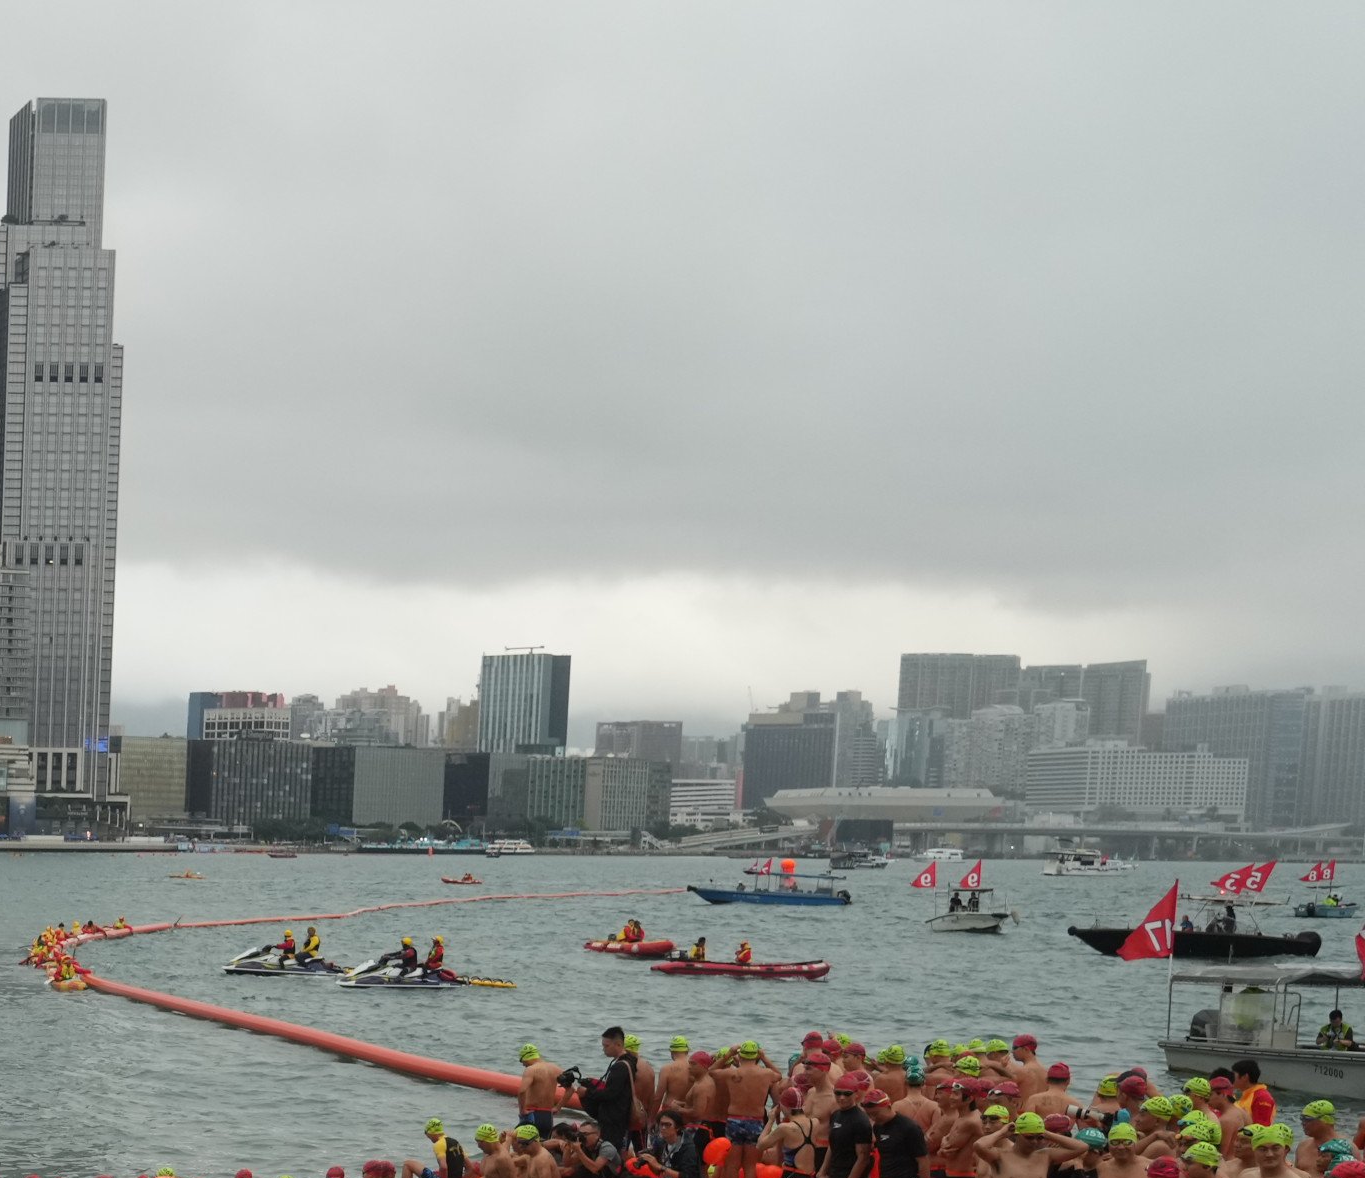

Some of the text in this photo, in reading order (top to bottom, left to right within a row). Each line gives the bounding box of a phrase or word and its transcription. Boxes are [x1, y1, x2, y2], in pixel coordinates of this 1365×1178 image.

[1308, 870, 1318, 882] 8
[1322, 868, 1331, 880] 8
[1313, 1064, 1345, 1079] 712000
